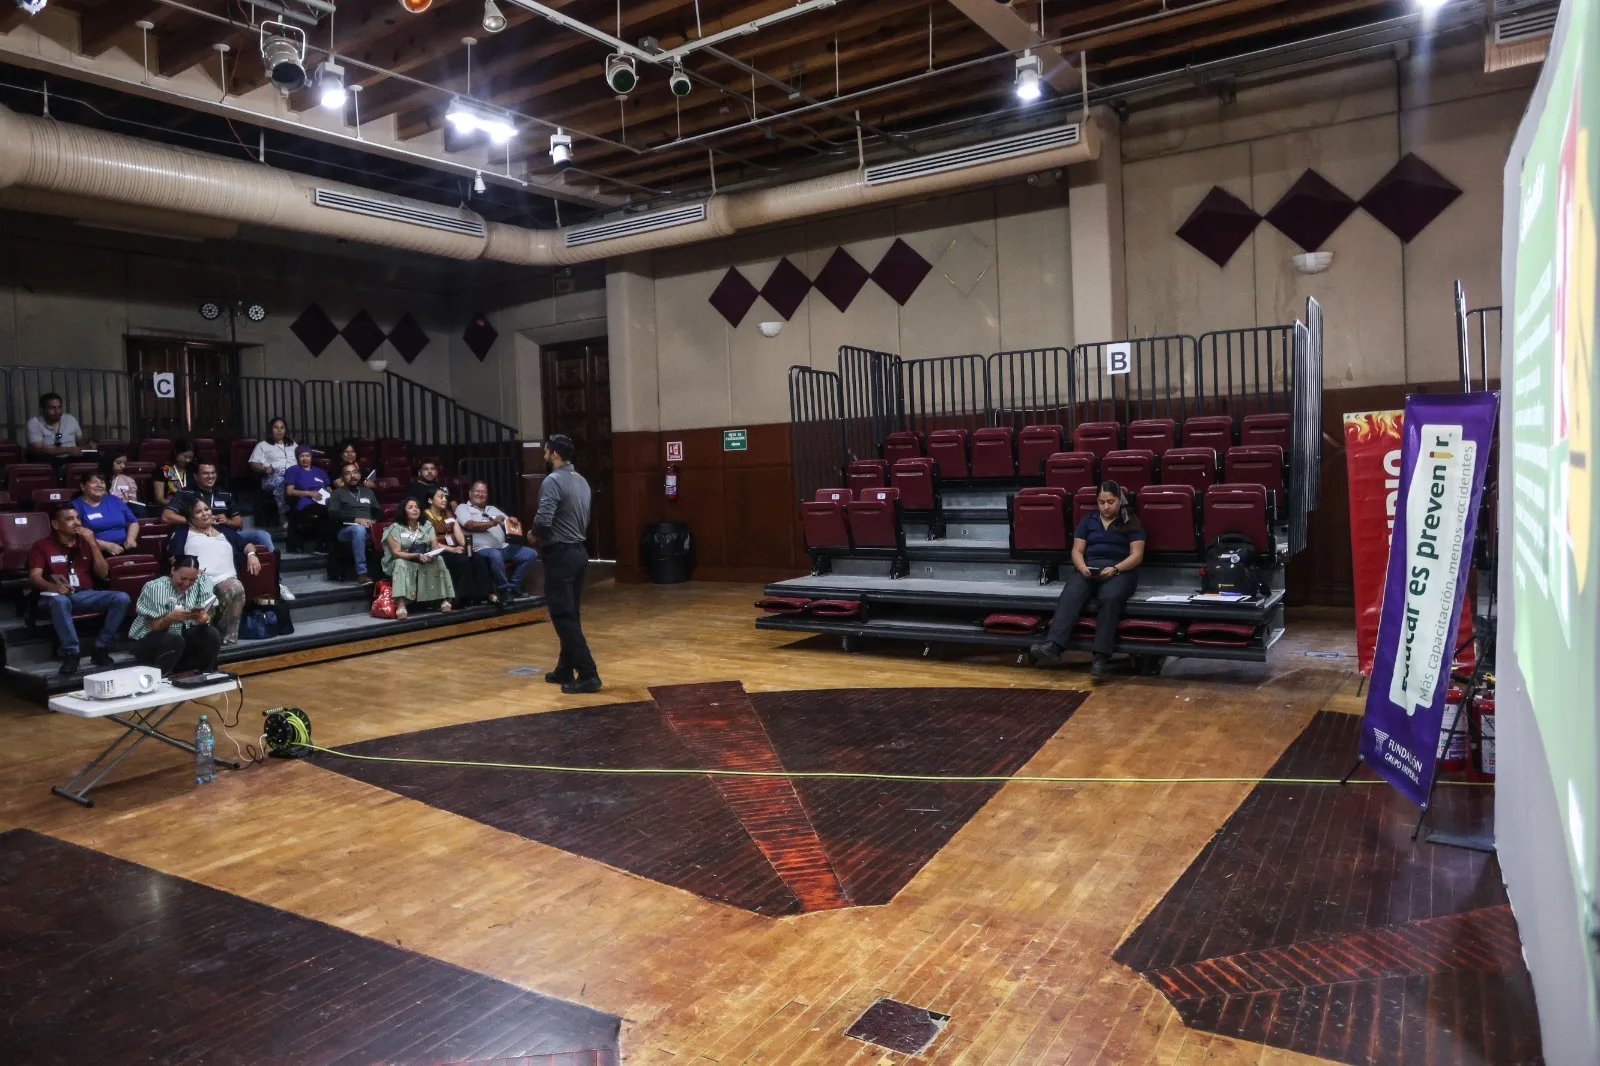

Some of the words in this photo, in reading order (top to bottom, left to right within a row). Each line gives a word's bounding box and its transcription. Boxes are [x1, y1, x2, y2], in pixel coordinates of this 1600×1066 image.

[1111, 352, 1127, 372] B
[157, 379, 171, 395] C
[1409, 565, 1430, 596] es
[1420, 675, 1434, 702] Más
[1428, 577, 1455, 670] capacitación,
[1448, 528, 1462, 574] menos
[1457, 446, 1473, 523] accidentes
[1384, 752, 1402, 768] GRUPO
[1388, 739, 1422, 772] FUNDAÓN
